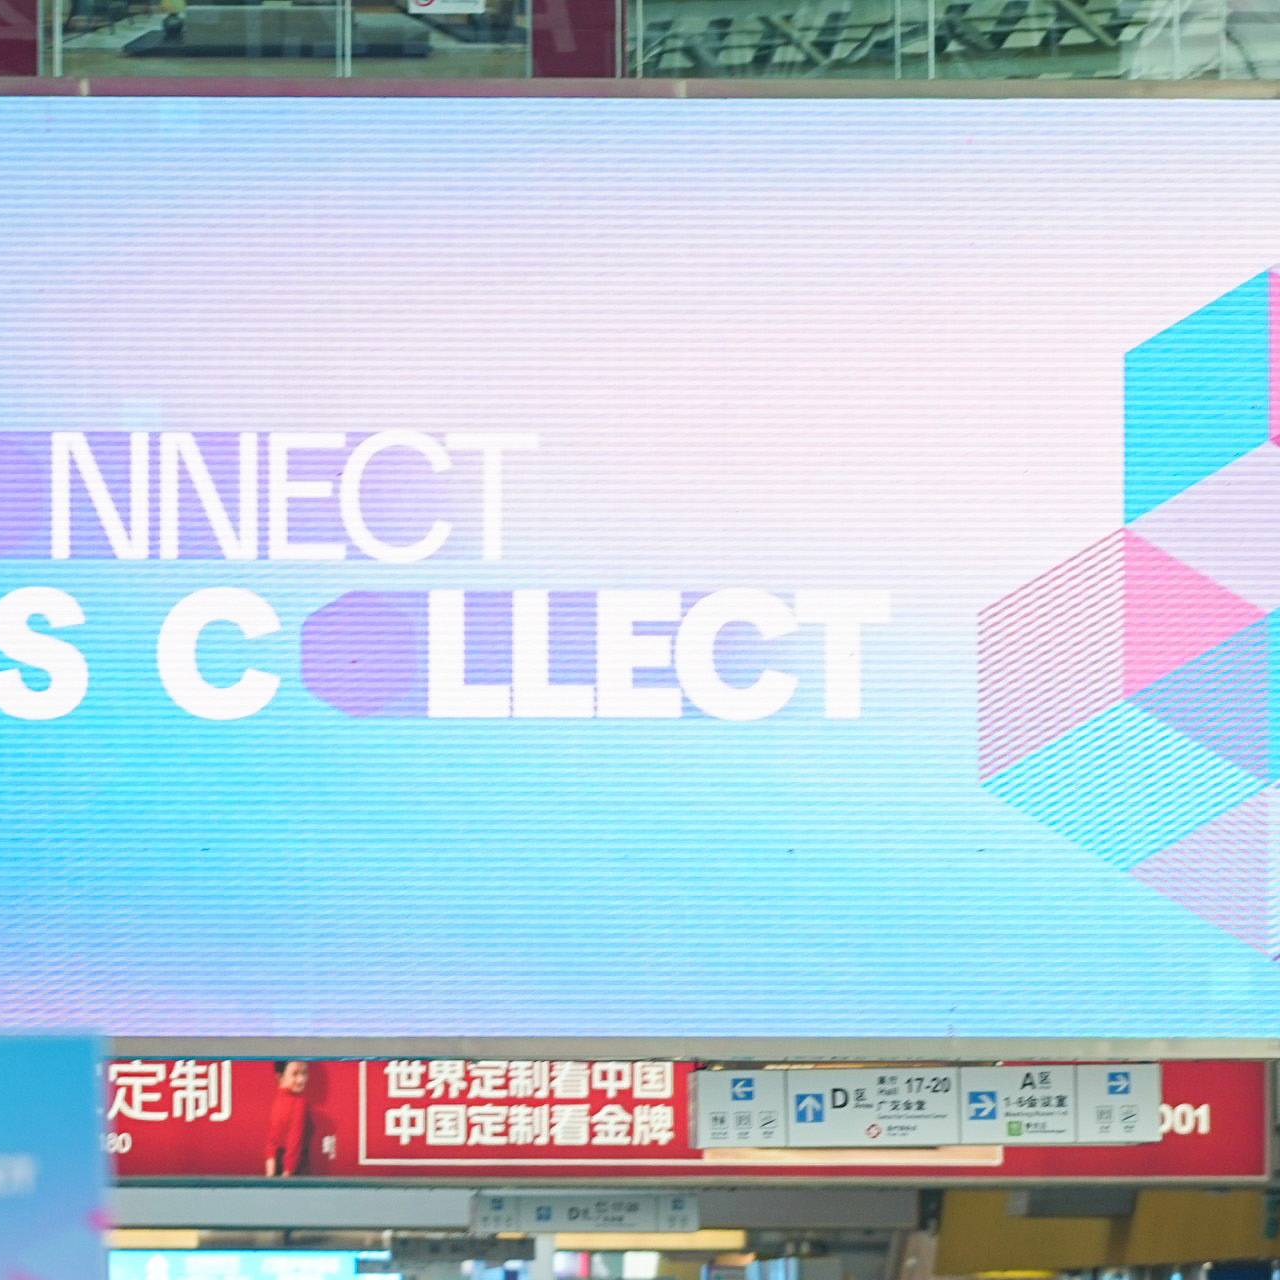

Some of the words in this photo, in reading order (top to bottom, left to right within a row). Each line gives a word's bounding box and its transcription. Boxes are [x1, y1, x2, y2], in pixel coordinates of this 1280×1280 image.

[155, 586, 891, 721] CLLECT
[107, 1060, 232, 1122] 定制
[384, 1060, 675, 1099] 世界定制看中国
[384, 1104, 675, 1148] 中国定制看金牌
